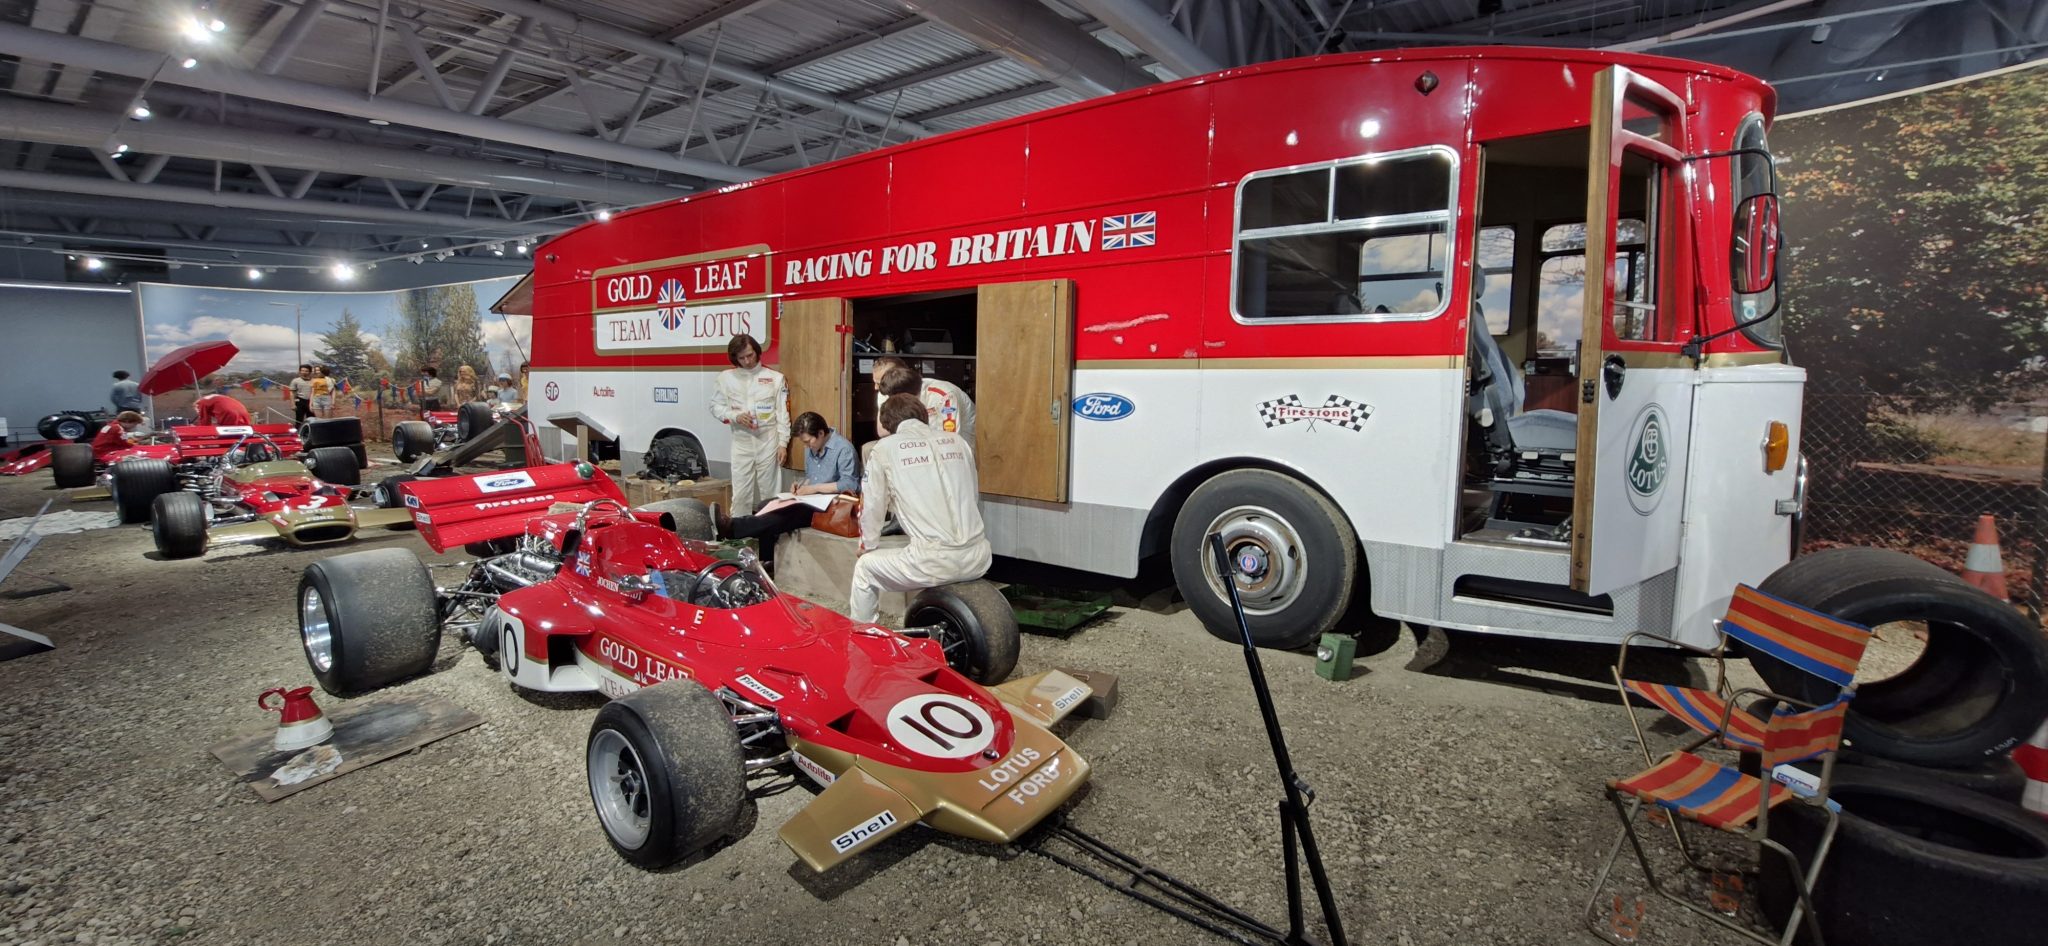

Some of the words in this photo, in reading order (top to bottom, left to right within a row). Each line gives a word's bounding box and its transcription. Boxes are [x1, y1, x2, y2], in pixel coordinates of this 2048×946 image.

[785, 249, 873, 286] RACING
[880, 241, 937, 275] FOR
[947, 219, 1097, 267] BRITAIN
[607, 275, 653, 302] GOLD
[694, 261, 748, 294] LEAF
[609, 318, 652, 342] TEAM
[693, 310, 751, 338] LOTUS
[545, 382, 559, 400] STP
[593, 386, 615, 397] Autolite
[655, 388, 678, 402] GIRLING
[1081, 395, 1122, 417] Ford
[1278, 406, 1349, 418] Firestone
[899, 441, 927, 450] GOLD
[901, 455, 930, 466] TEAM
[1630, 456, 1667, 489] LOTUS
[297, 495, 328, 510] 3
[475, 494, 555, 510] Firestone
[597, 576, 619, 592] JOCHEN
[694, 610, 705, 624] E
[600, 637, 639, 669] GOLD
[601, 675, 631, 696] TEA
[740, 676, 780, 700] Firestone
[1054, 686, 1086, 710] Shell
[900, 700, 984, 752] 10
[798, 756, 832, 783] Autolite
[978, 747, 1042, 793] LOTUS
[1008, 758, 1061, 806] FORD
[835, 811, 895, 850] Shell
